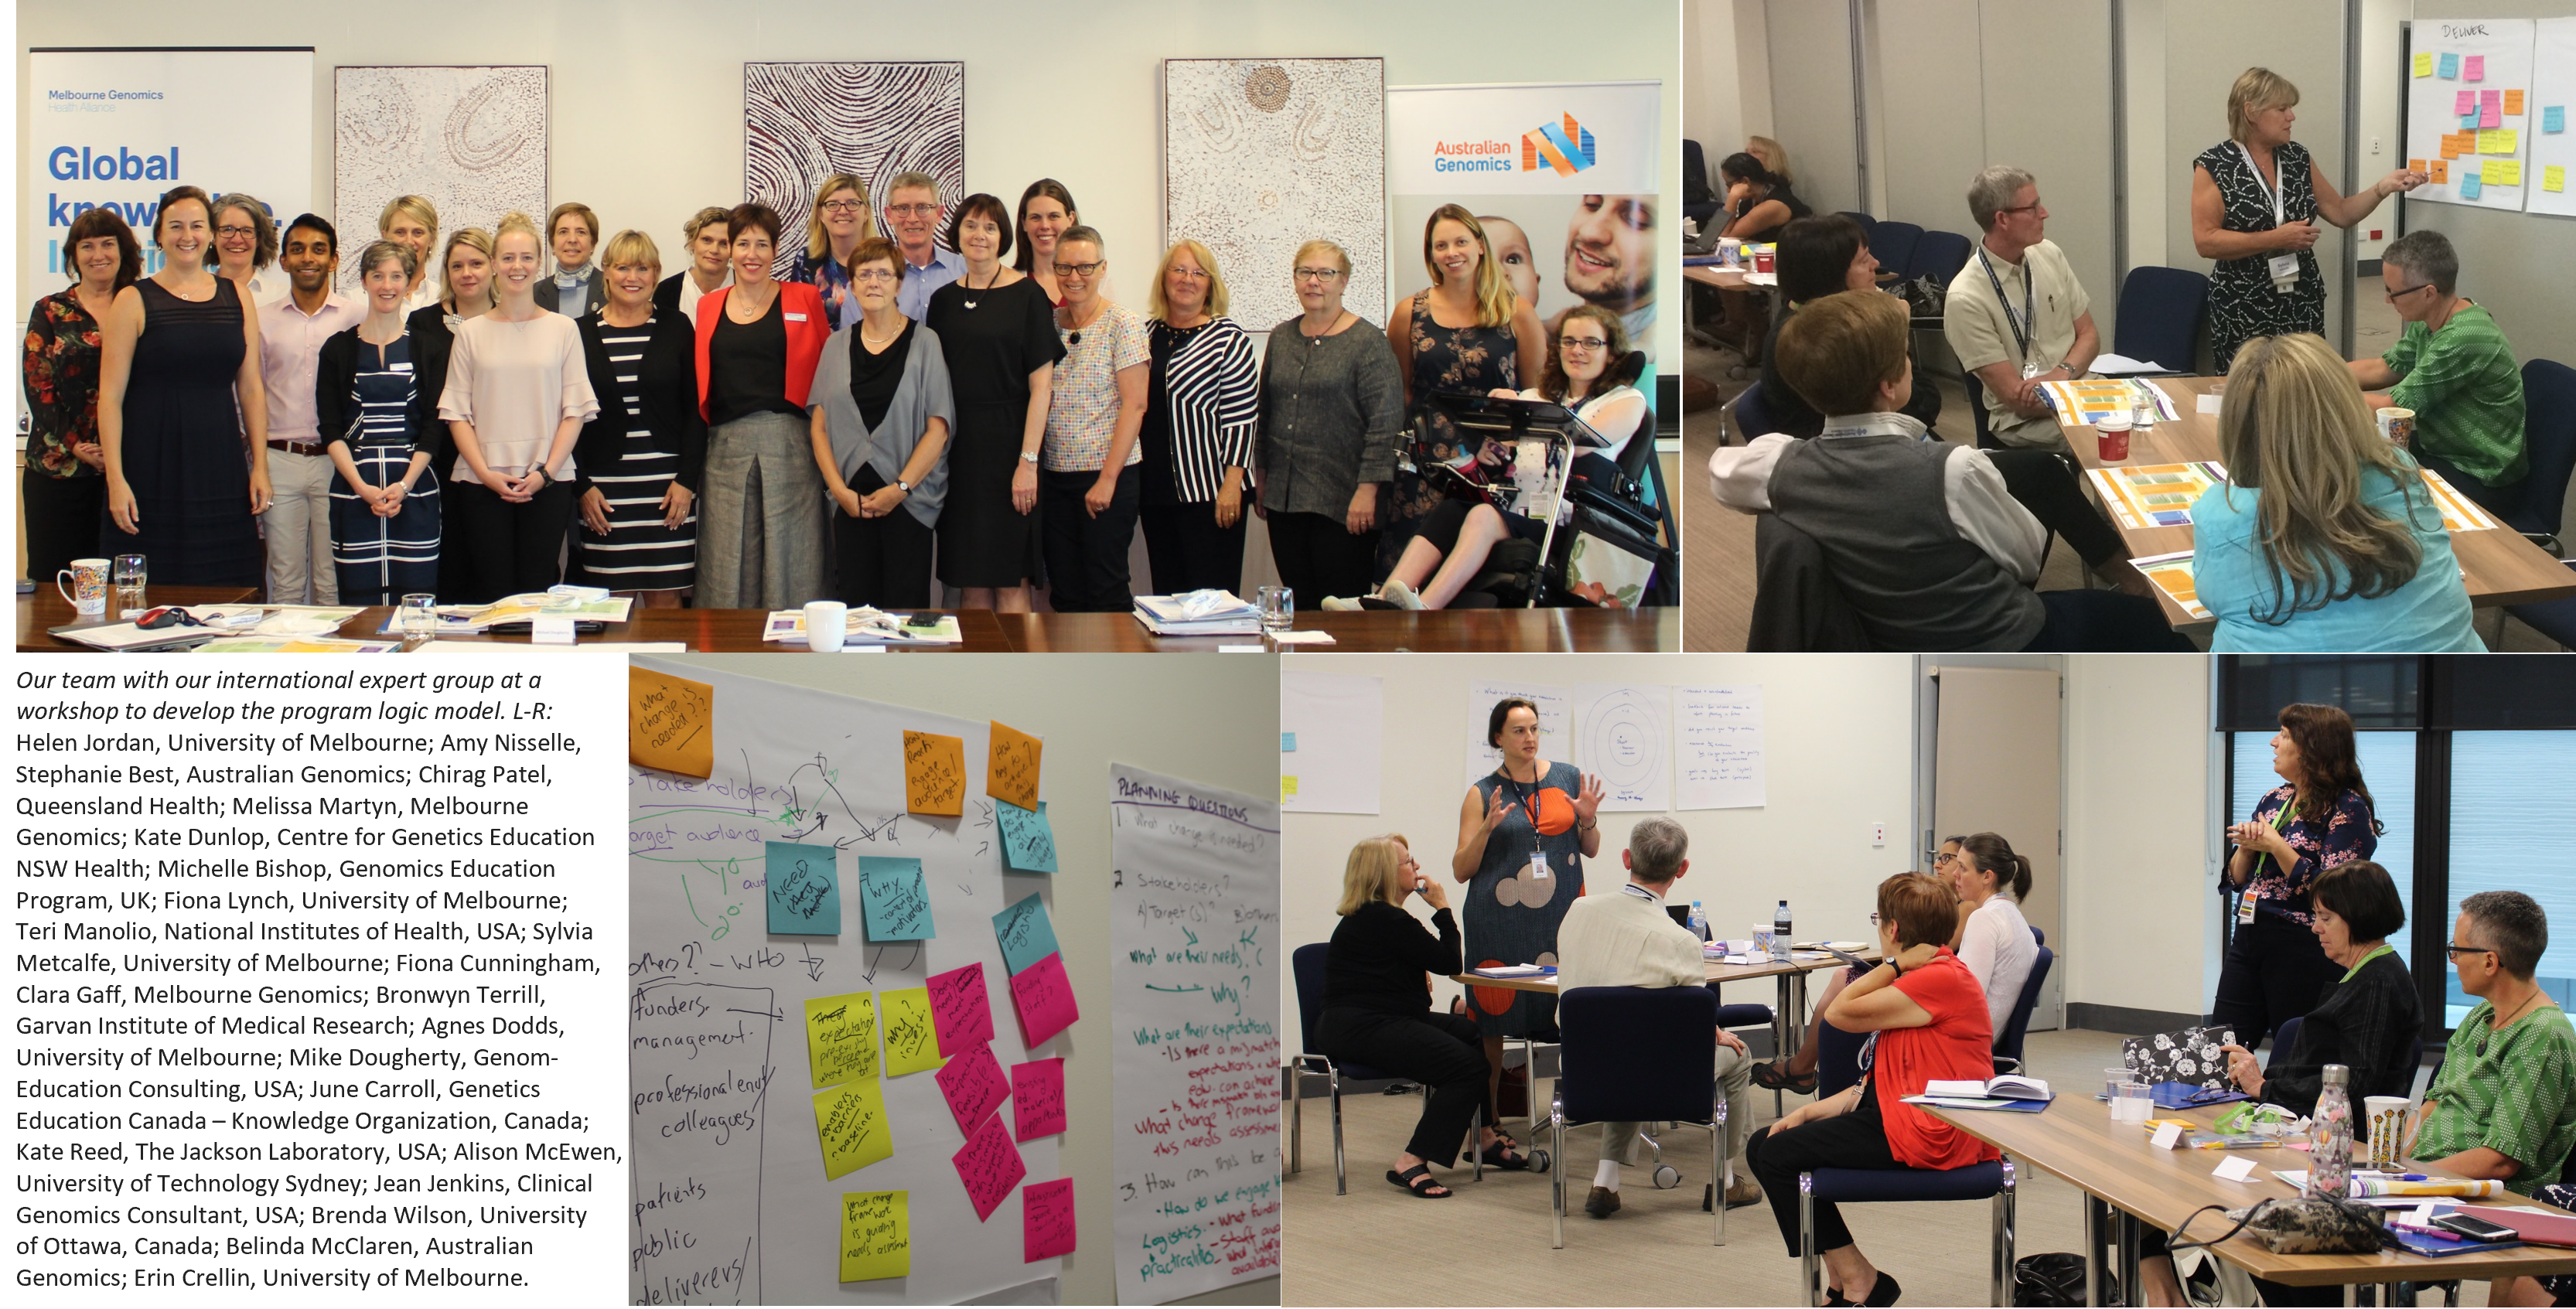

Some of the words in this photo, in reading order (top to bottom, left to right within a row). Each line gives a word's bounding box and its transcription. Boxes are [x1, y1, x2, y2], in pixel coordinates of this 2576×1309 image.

[2441, 24, 2489, 39] DELIVER
[49, 90, 105, 100] Melbourne
[108, 90, 164, 100] Genomics
[49, 103, 78, 112] Health
[80, 103, 116, 112] Alliance
[1435, 141, 1510, 155] Australian
[49, 145, 179, 180] Global
[1435, 157, 1511, 172] Genomics
[1117, 777, 1181, 803] PLANNING
[1189, 795, 1249, 822] QUESTIONS
[1134, 813, 1158, 829] What
[730, 947, 785, 971] WHO
[1130, 947, 1158, 965] What
[1166, 953, 1182, 964] are
[1134, 1027, 1162, 1046] What
[1165, 1029, 1181, 1041] are
[1134, 1116, 1171, 1135] What
[633, 1228, 697, 1271] public
